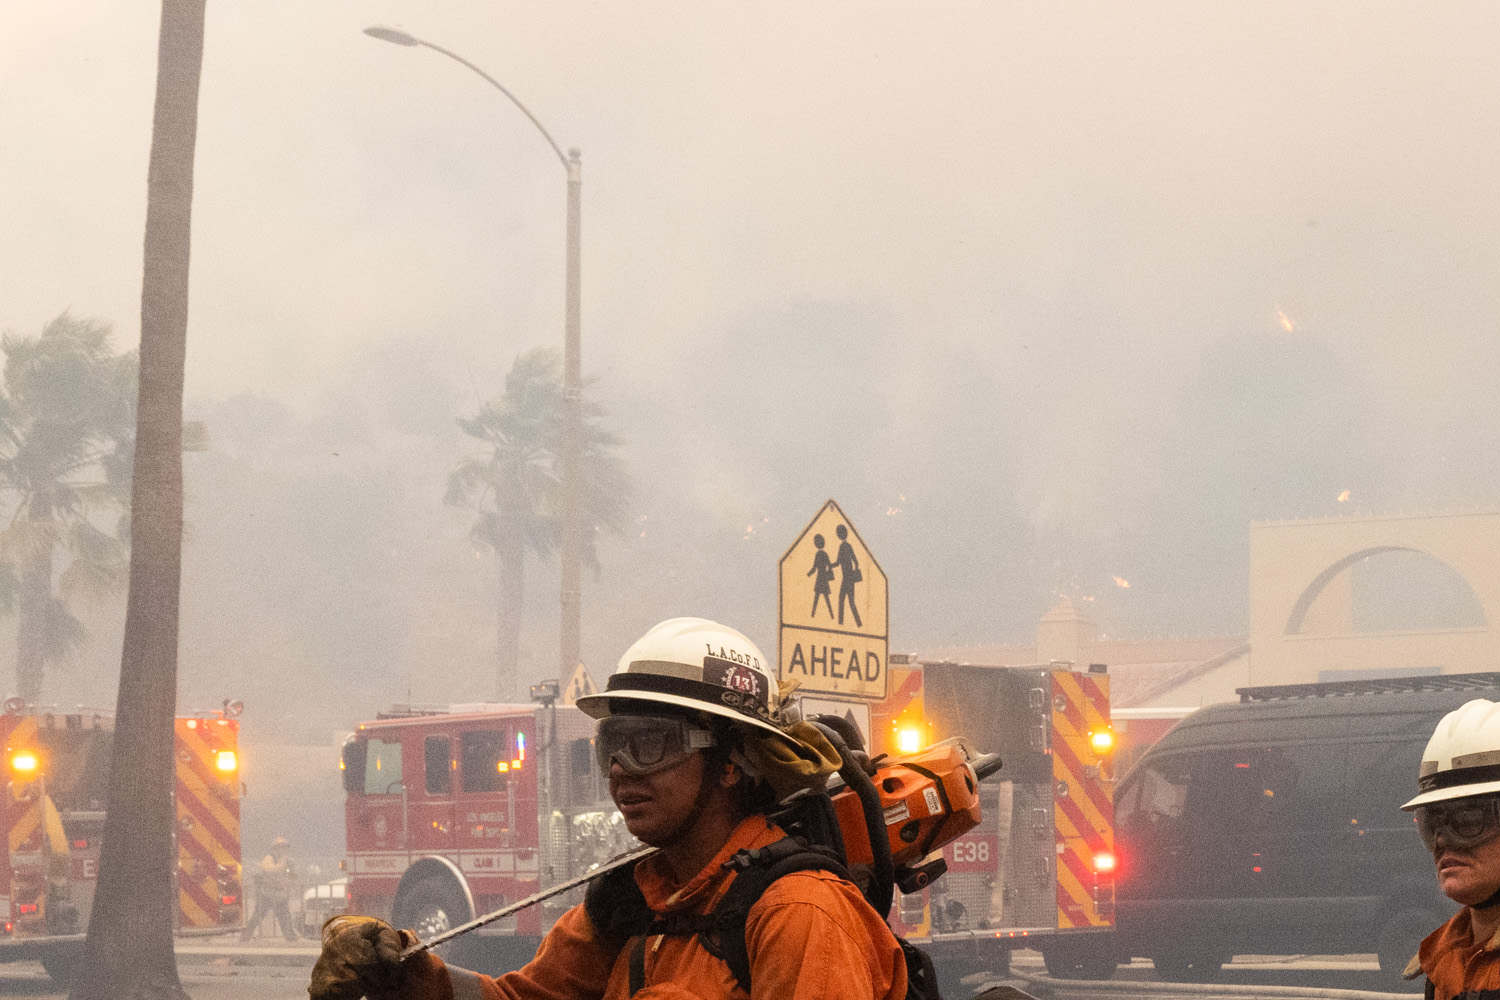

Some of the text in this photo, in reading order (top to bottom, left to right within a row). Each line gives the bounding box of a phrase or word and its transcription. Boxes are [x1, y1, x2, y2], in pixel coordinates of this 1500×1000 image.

[788, 643, 880, 682] AHEAD
[734, 675, 751, 691] 13
[953, 841, 989, 862] E38
